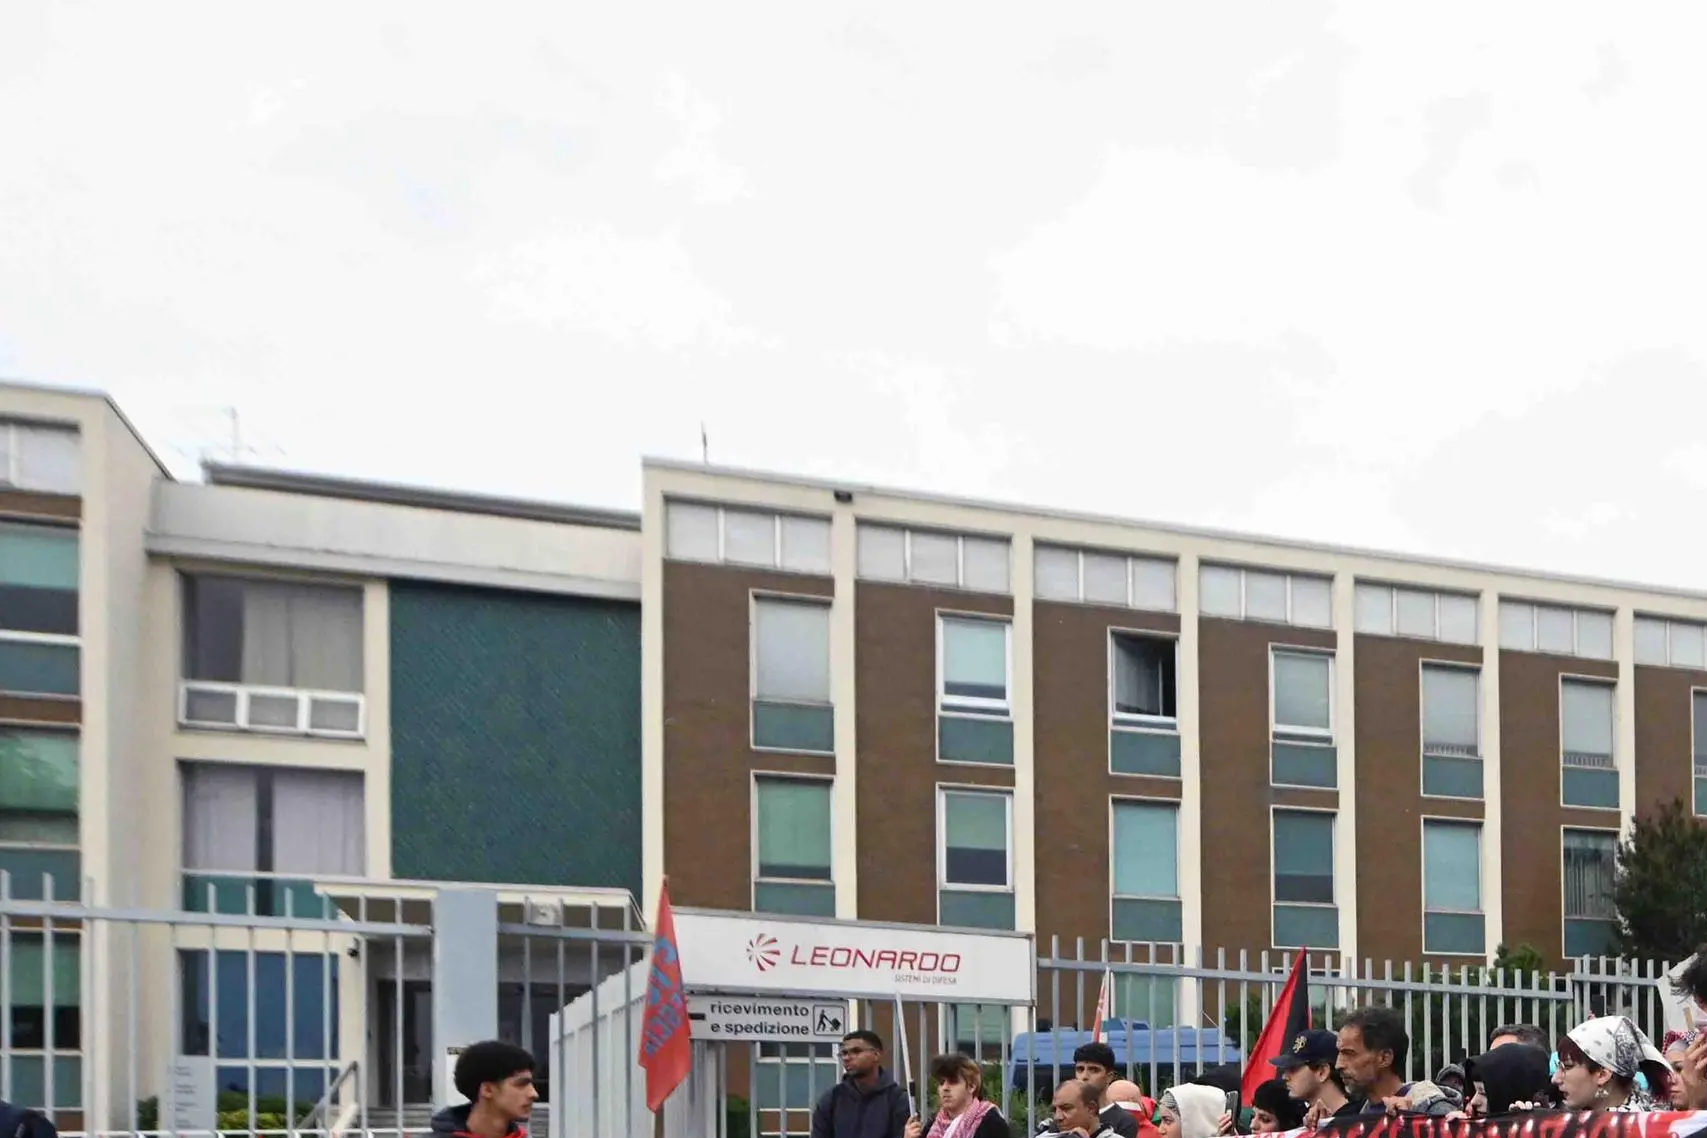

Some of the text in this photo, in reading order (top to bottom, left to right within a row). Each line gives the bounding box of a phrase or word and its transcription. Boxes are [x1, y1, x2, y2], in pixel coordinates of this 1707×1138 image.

[790, 944, 961, 973] LEONARDO
[710, 1001, 809, 1017] ricevimento
[710, 1021, 809, 1036] e spedizione
